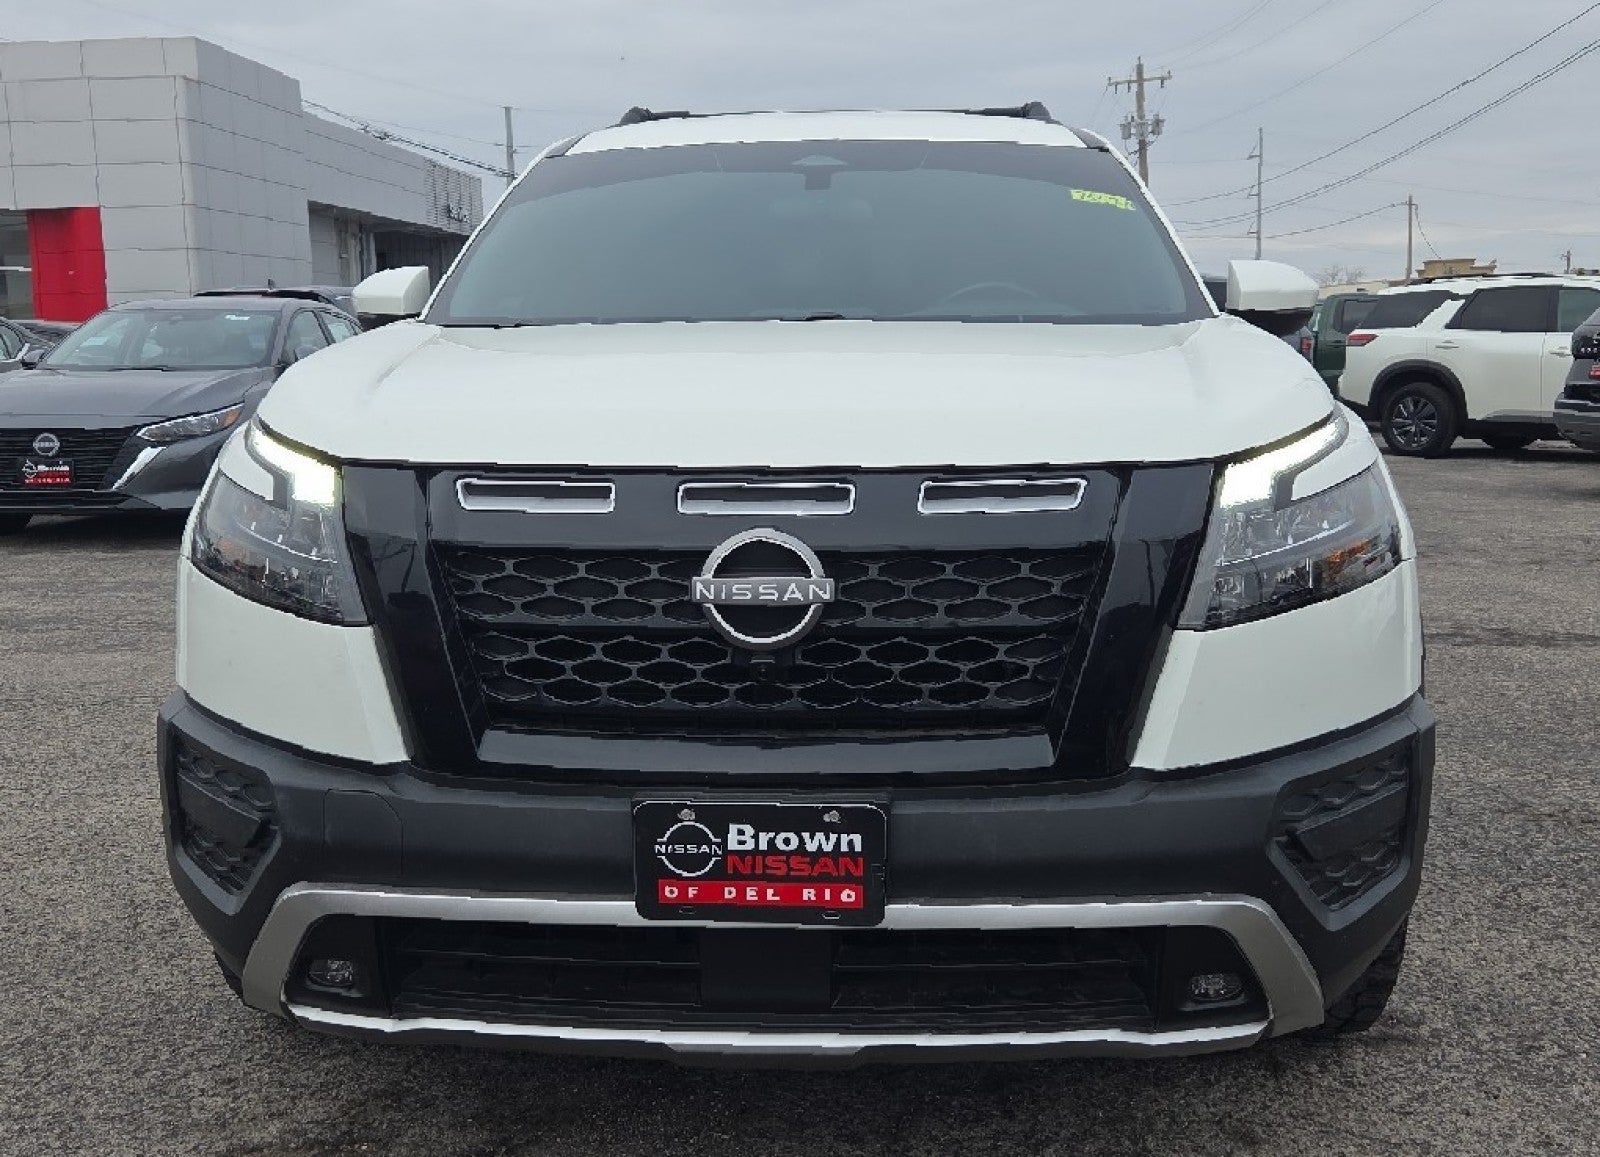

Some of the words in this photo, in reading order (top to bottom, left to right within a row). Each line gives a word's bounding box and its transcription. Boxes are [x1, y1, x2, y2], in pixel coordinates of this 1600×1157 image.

[695, 582, 831, 602] NISSAN
[727, 823, 862, 852] Brown
[654, 844, 722, 855] NISSAN
[727, 855, 863, 876] NISSAN
[664, 886, 699, 898] OF
[724, 887, 780, 901] DEL
[802, 888, 856, 903] RIO
